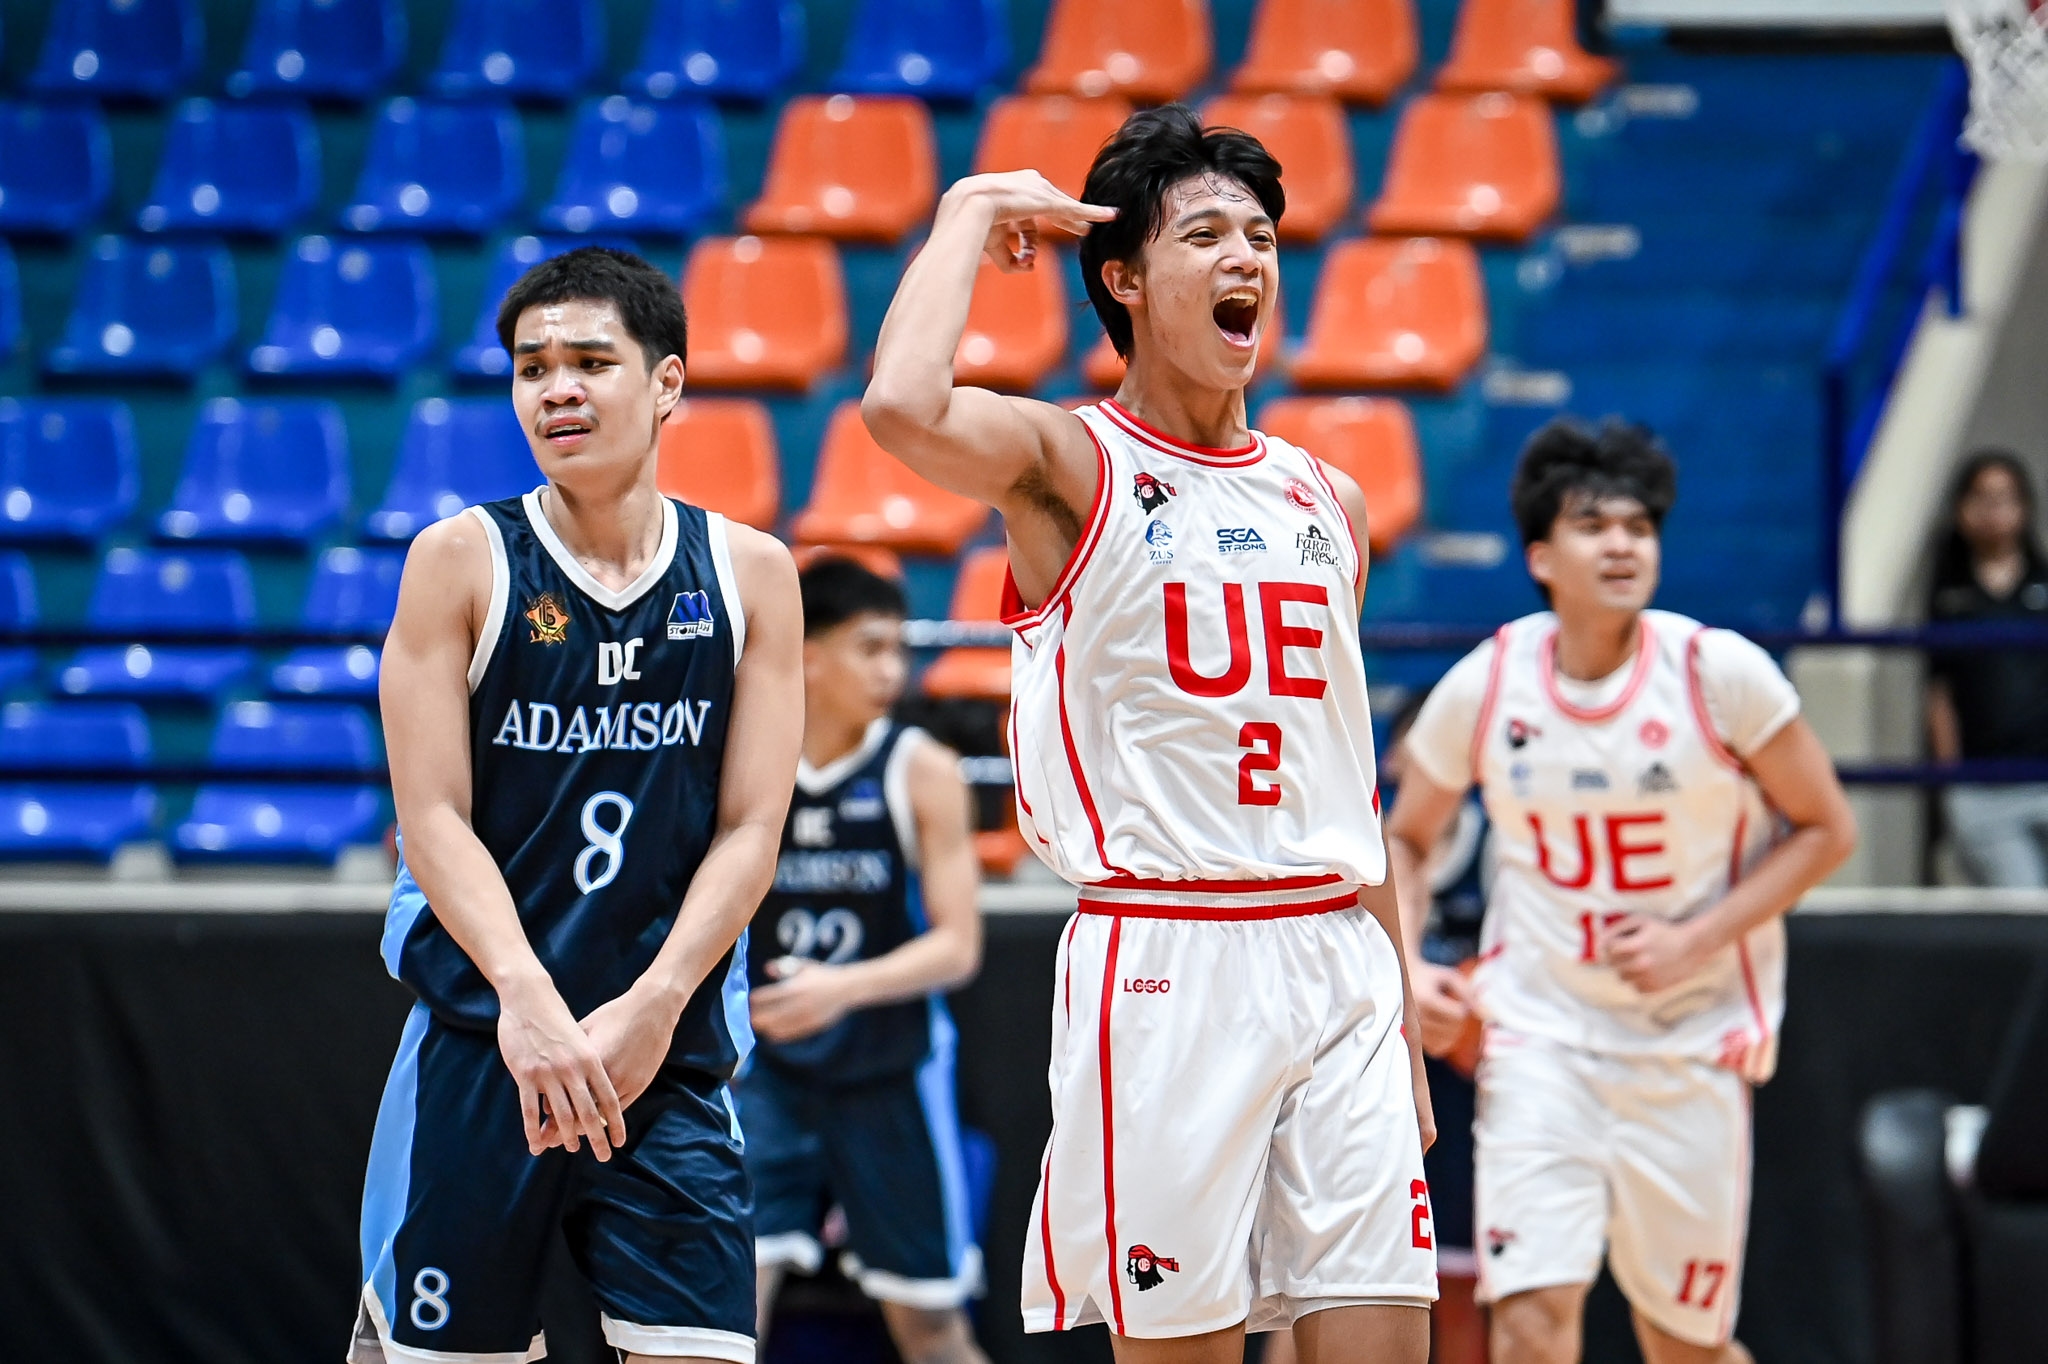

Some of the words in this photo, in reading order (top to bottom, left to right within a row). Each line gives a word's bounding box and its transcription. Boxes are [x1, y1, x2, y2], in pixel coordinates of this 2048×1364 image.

[1149, 550, 1174, 560] ZUS
[1216, 528, 1264, 544] SGA
[1218, 543, 1267, 552] STRONG
[598, 638, 643, 685] DC
[1163, 581, 1329, 700] UE
[492, 698, 711, 753] ADAMSON
[1238, 722, 1282, 806] 2
[573, 790, 634, 895] 8
[1527, 811, 1674, 892] UE
[776, 908, 864, 964] 22
[1410, 1178, 1432, 1251] 2
[410, 1266, 450, 1331] 8
[1677, 1260, 1727, 1309] 17
